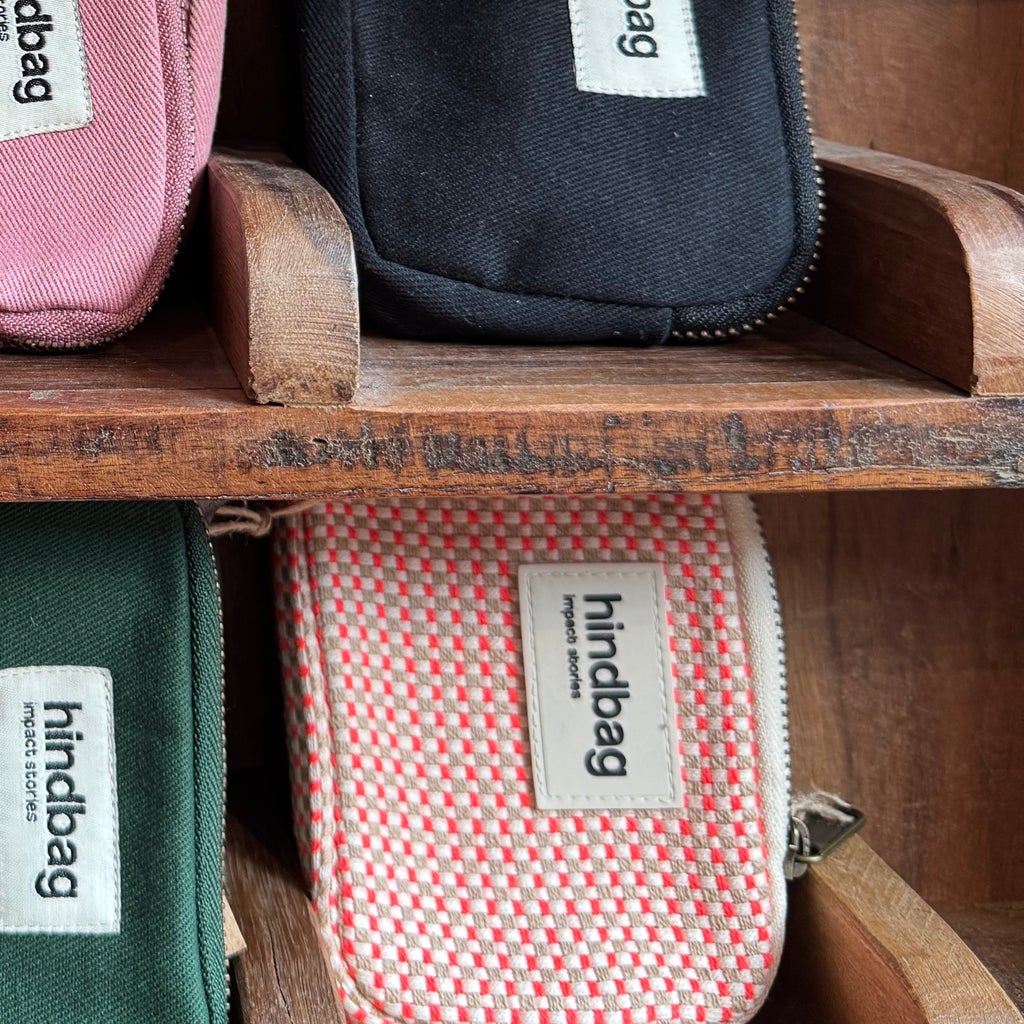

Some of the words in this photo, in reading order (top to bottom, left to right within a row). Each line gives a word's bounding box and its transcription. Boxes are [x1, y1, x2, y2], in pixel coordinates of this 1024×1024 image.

[560, 593, 578, 645] impact
[567, 648, 583, 699] stories
[582, 593, 631, 777] hindbag
[21, 701, 38, 757] impact
[25, 761, 38, 823] stories
[34, 701, 87, 899] hindbag
